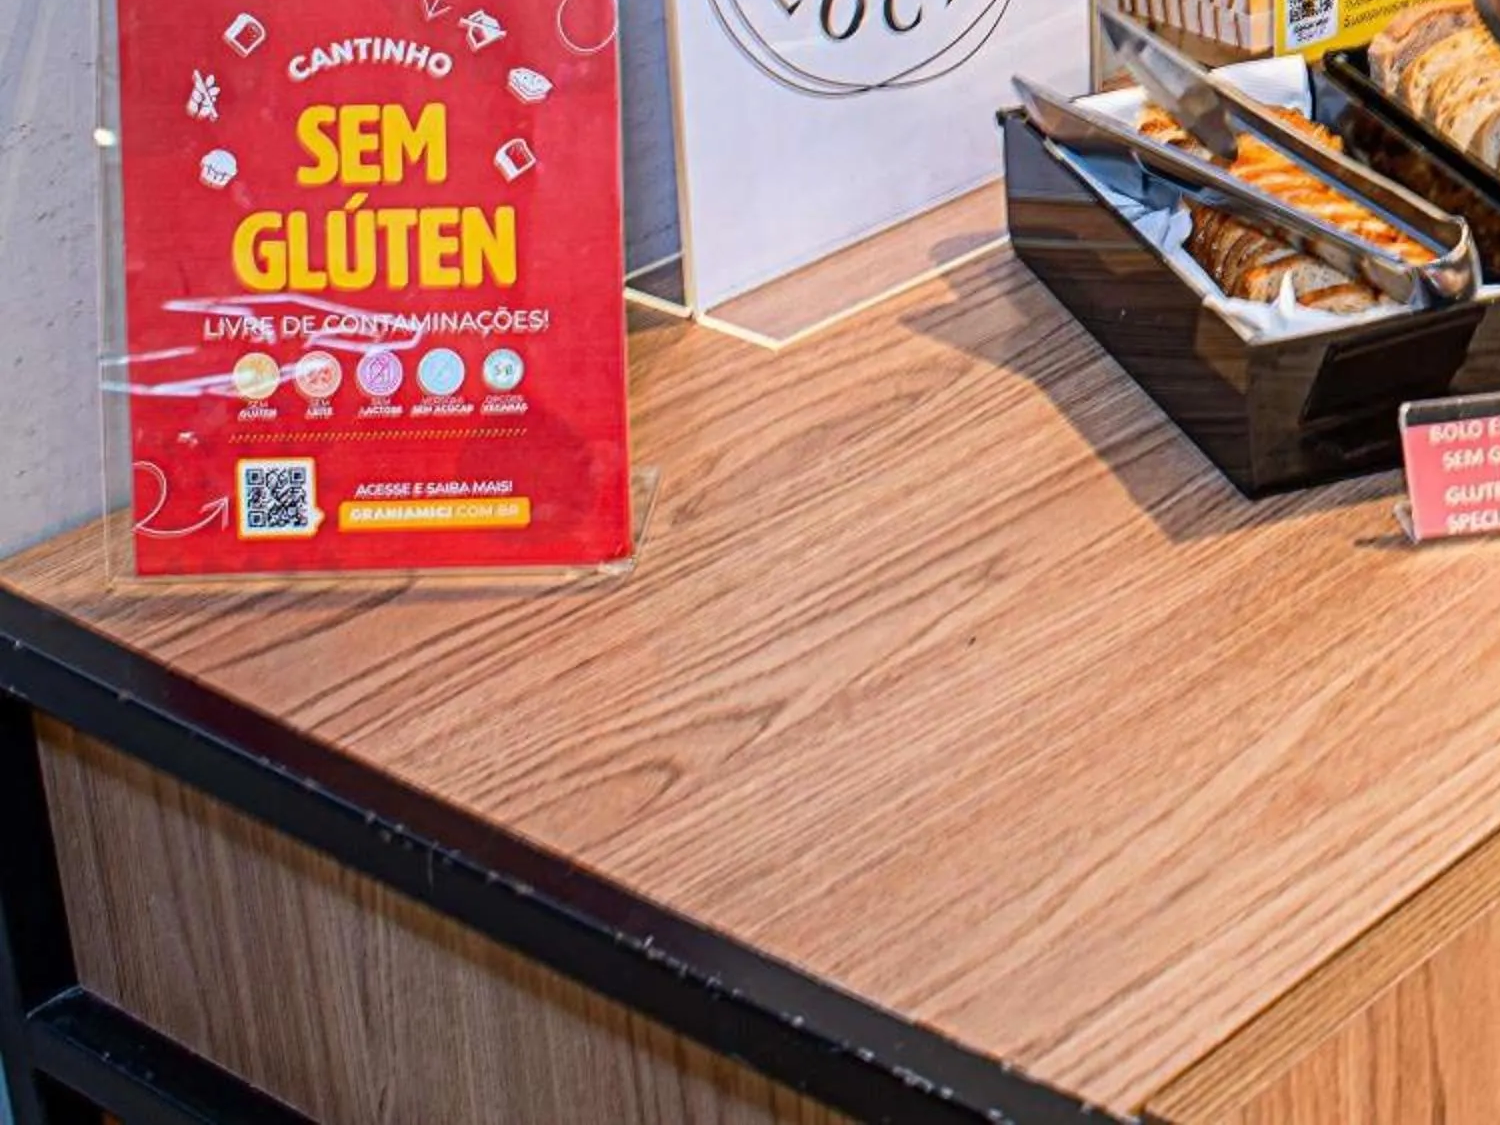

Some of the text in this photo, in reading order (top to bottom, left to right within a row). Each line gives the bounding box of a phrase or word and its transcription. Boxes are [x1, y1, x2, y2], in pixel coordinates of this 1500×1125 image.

[288, 37, 453, 81] CANTINHO
[296, 102, 447, 186] SEM
[232, 191, 518, 292] GLÚTEN
[203, 307, 549, 339] LIVRE DE CONTAMINAÇÕES!
[1428, 419, 1483, 444] BOLO
[1442, 448, 1484, 472] SEM
[355, 480, 513, 497] ACESSE E SAIBA MAIS!
